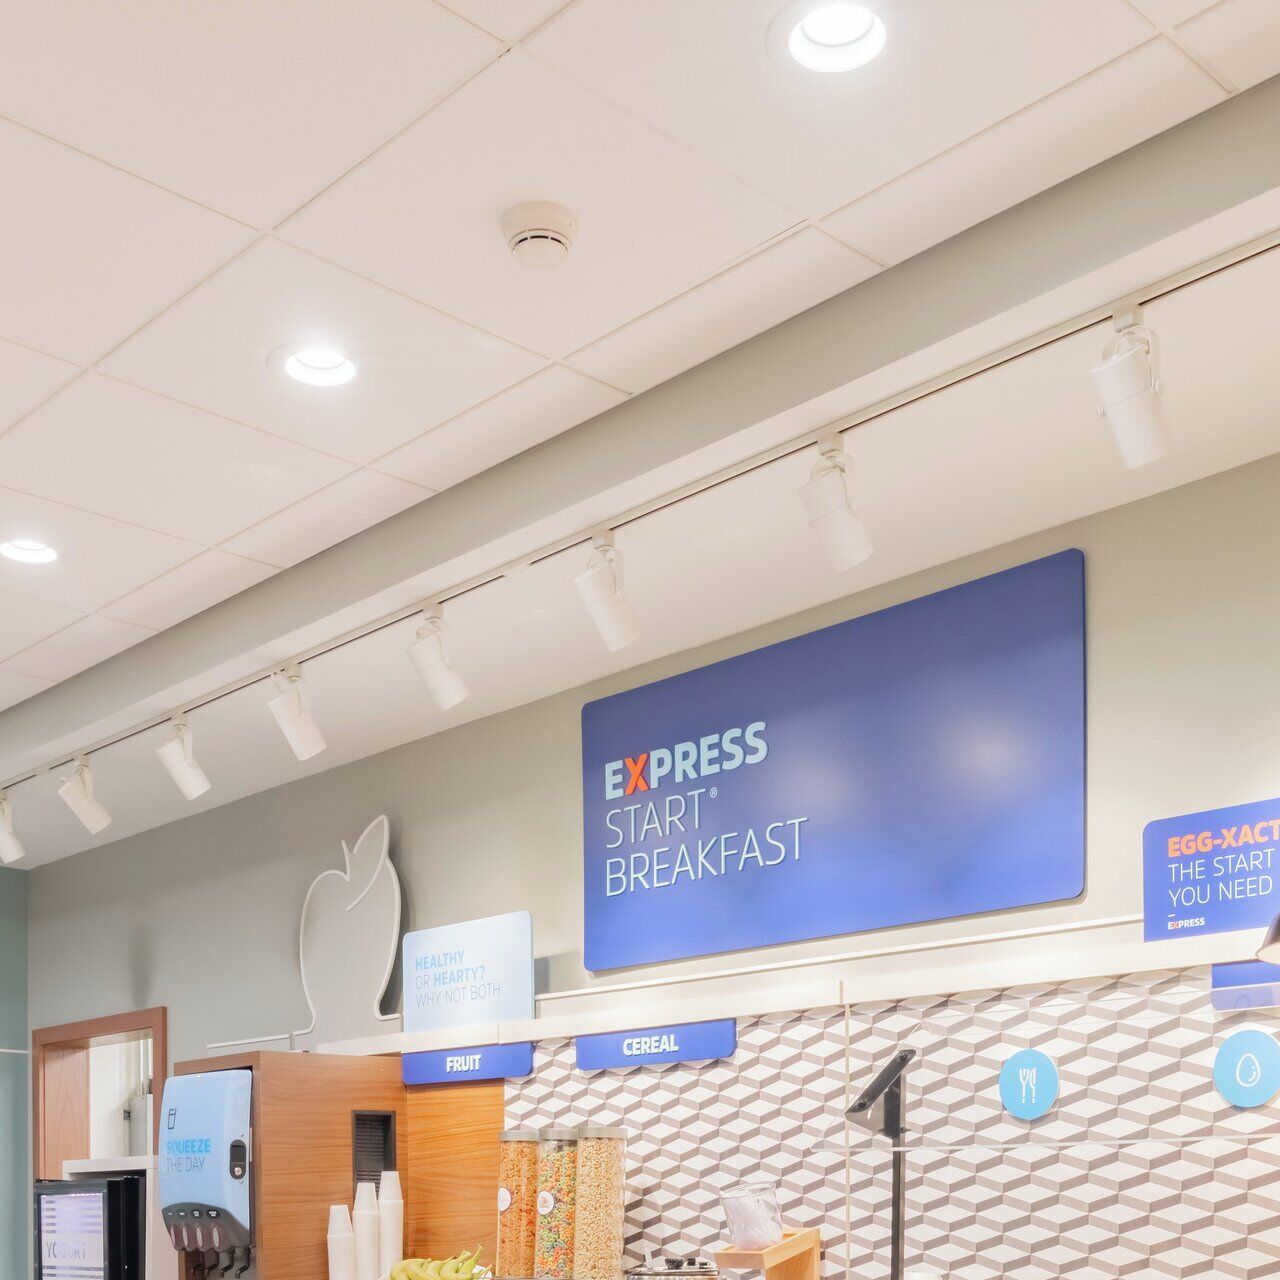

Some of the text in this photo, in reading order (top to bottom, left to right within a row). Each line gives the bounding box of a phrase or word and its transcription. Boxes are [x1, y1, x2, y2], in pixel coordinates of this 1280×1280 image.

[605, 721, 768, 800] EXPRESS
[606, 817, 809, 897] BREAKFAST
[1168, 848, 1276, 883] THE START
[1168, 875, 1273, 908] YOU NEED
[1167, 917, 1206, 930] EXPRESS
[415, 950, 465, 971] HEALTHY
[415, 965, 486, 990] OR HEARTY?
[416, 980, 502, 1008] WHY NOT BOTH
[623, 1034, 679, 1057] CEREAL
[446, 1054, 482, 1073] FRUIT
[167, 1138, 212, 1154] SQUEEZE
[167, 1156, 206, 1173] THE DAY
